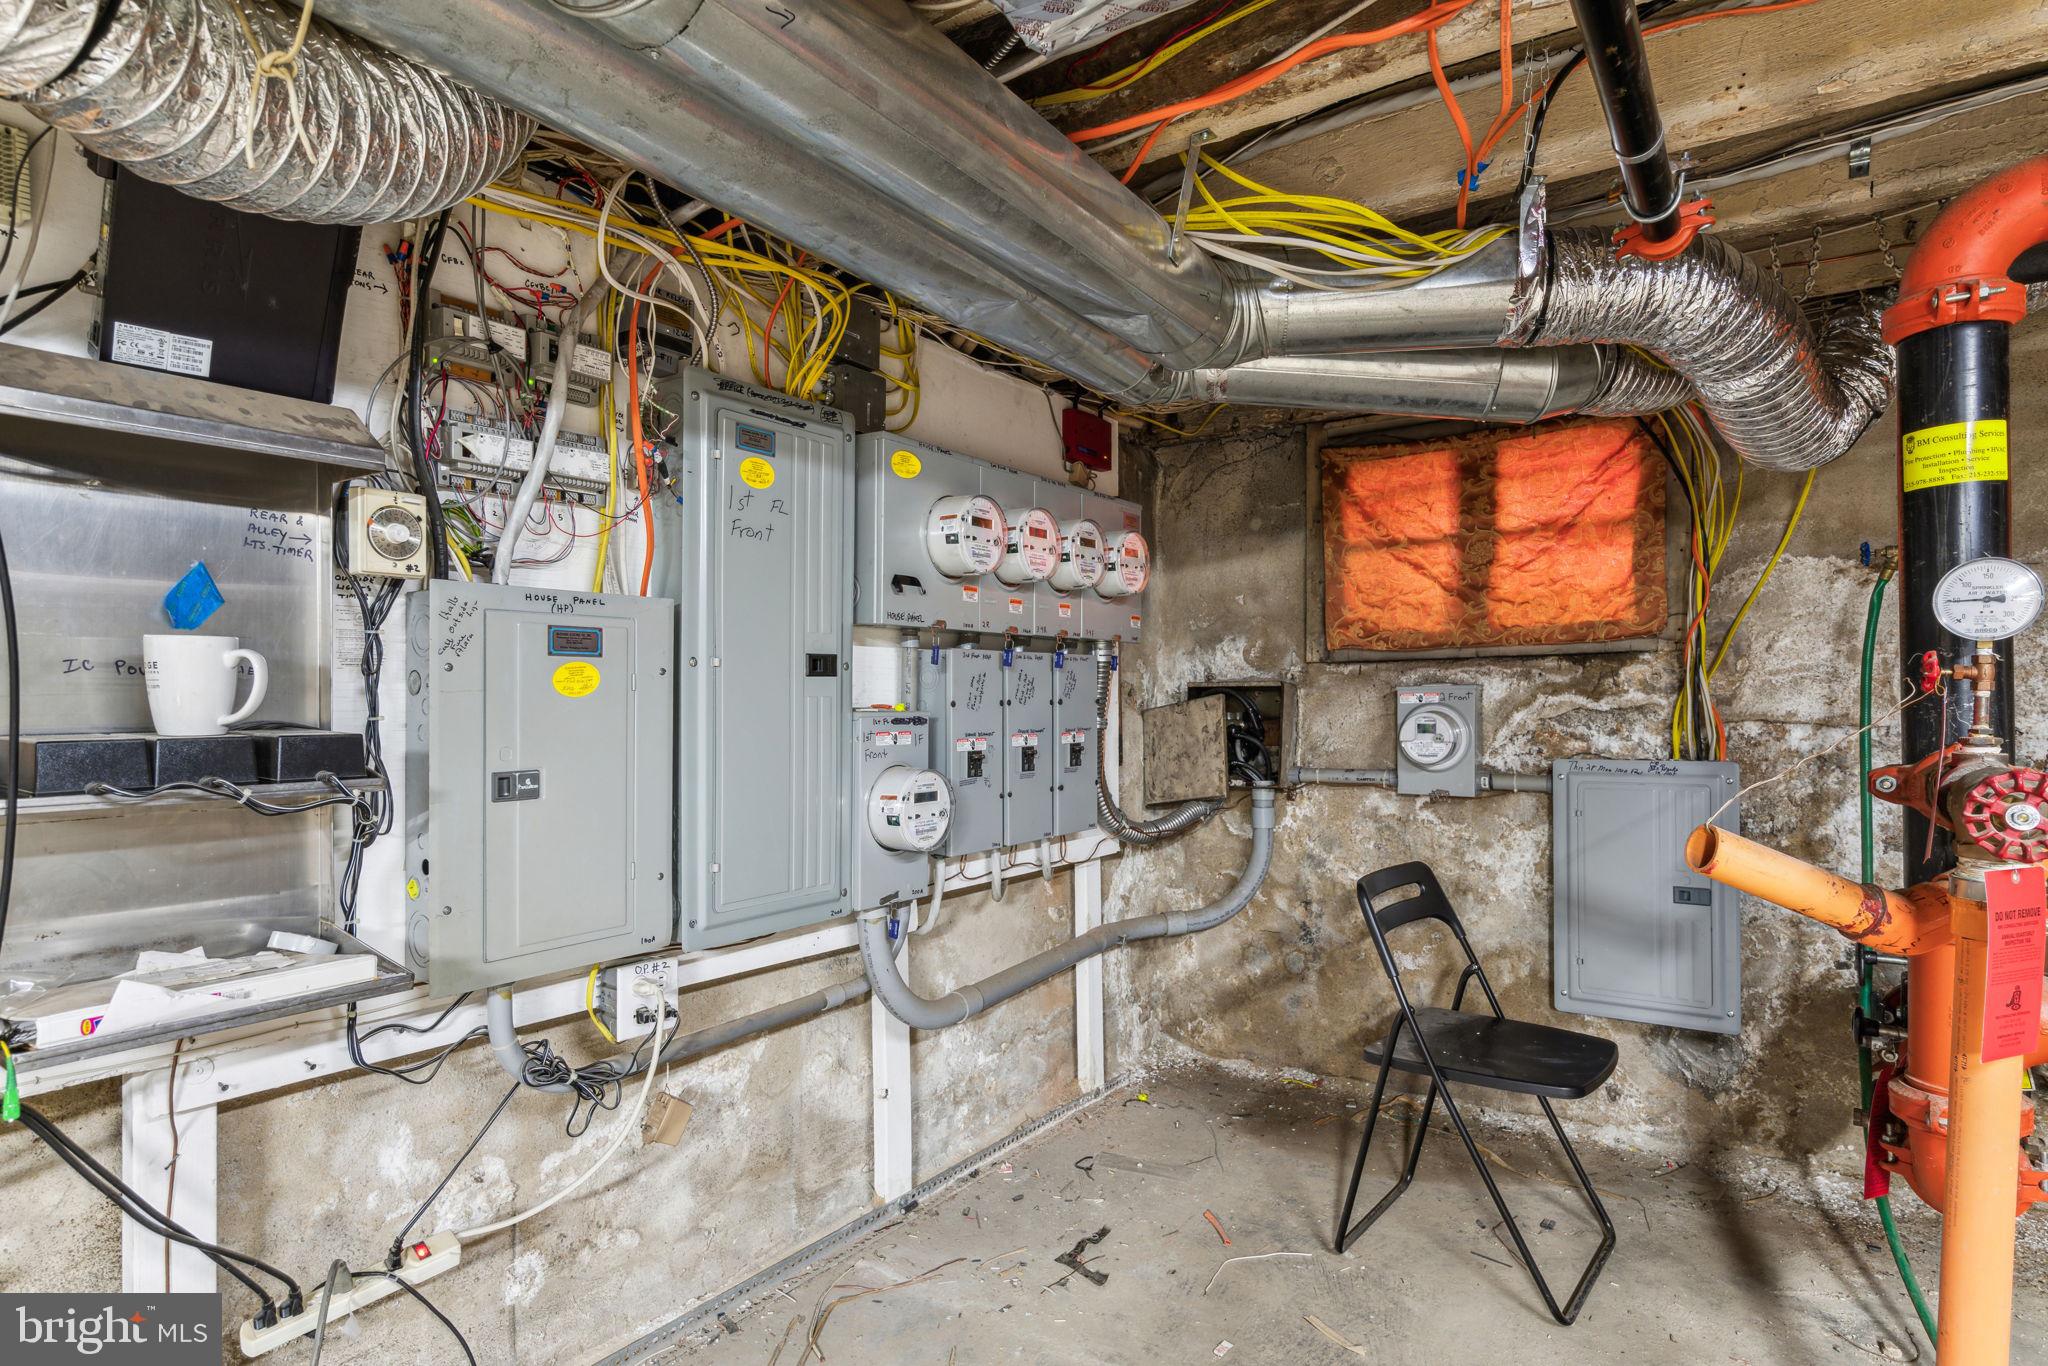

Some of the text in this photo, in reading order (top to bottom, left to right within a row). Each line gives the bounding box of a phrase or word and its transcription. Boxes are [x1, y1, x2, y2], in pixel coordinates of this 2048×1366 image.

[1916, 438, 1931, 447] BM
[1979, 429, 2005, 438] Services
[1915, 452, 1946, 463] Protection
[1922, 458, 1960, 470] Installation
[1938, 465, 1975, 474] Inspection
[250, 507, 304, 527] REAR &
[247, 523, 287, 546] ALLEY
[730, 518, 775, 542] Front
[405, 563, 421, 573] #2
[525, 593, 606, 606] HOUSE PANEL
[551, 602, 574, 614] (HP)
[886, 611, 905, 621] HOUSE
[1448, 691, 1473, 701] Front
[864, 748, 888, 762] Front
[1994, 906, 2041, 922] DO NOT REMOVE
